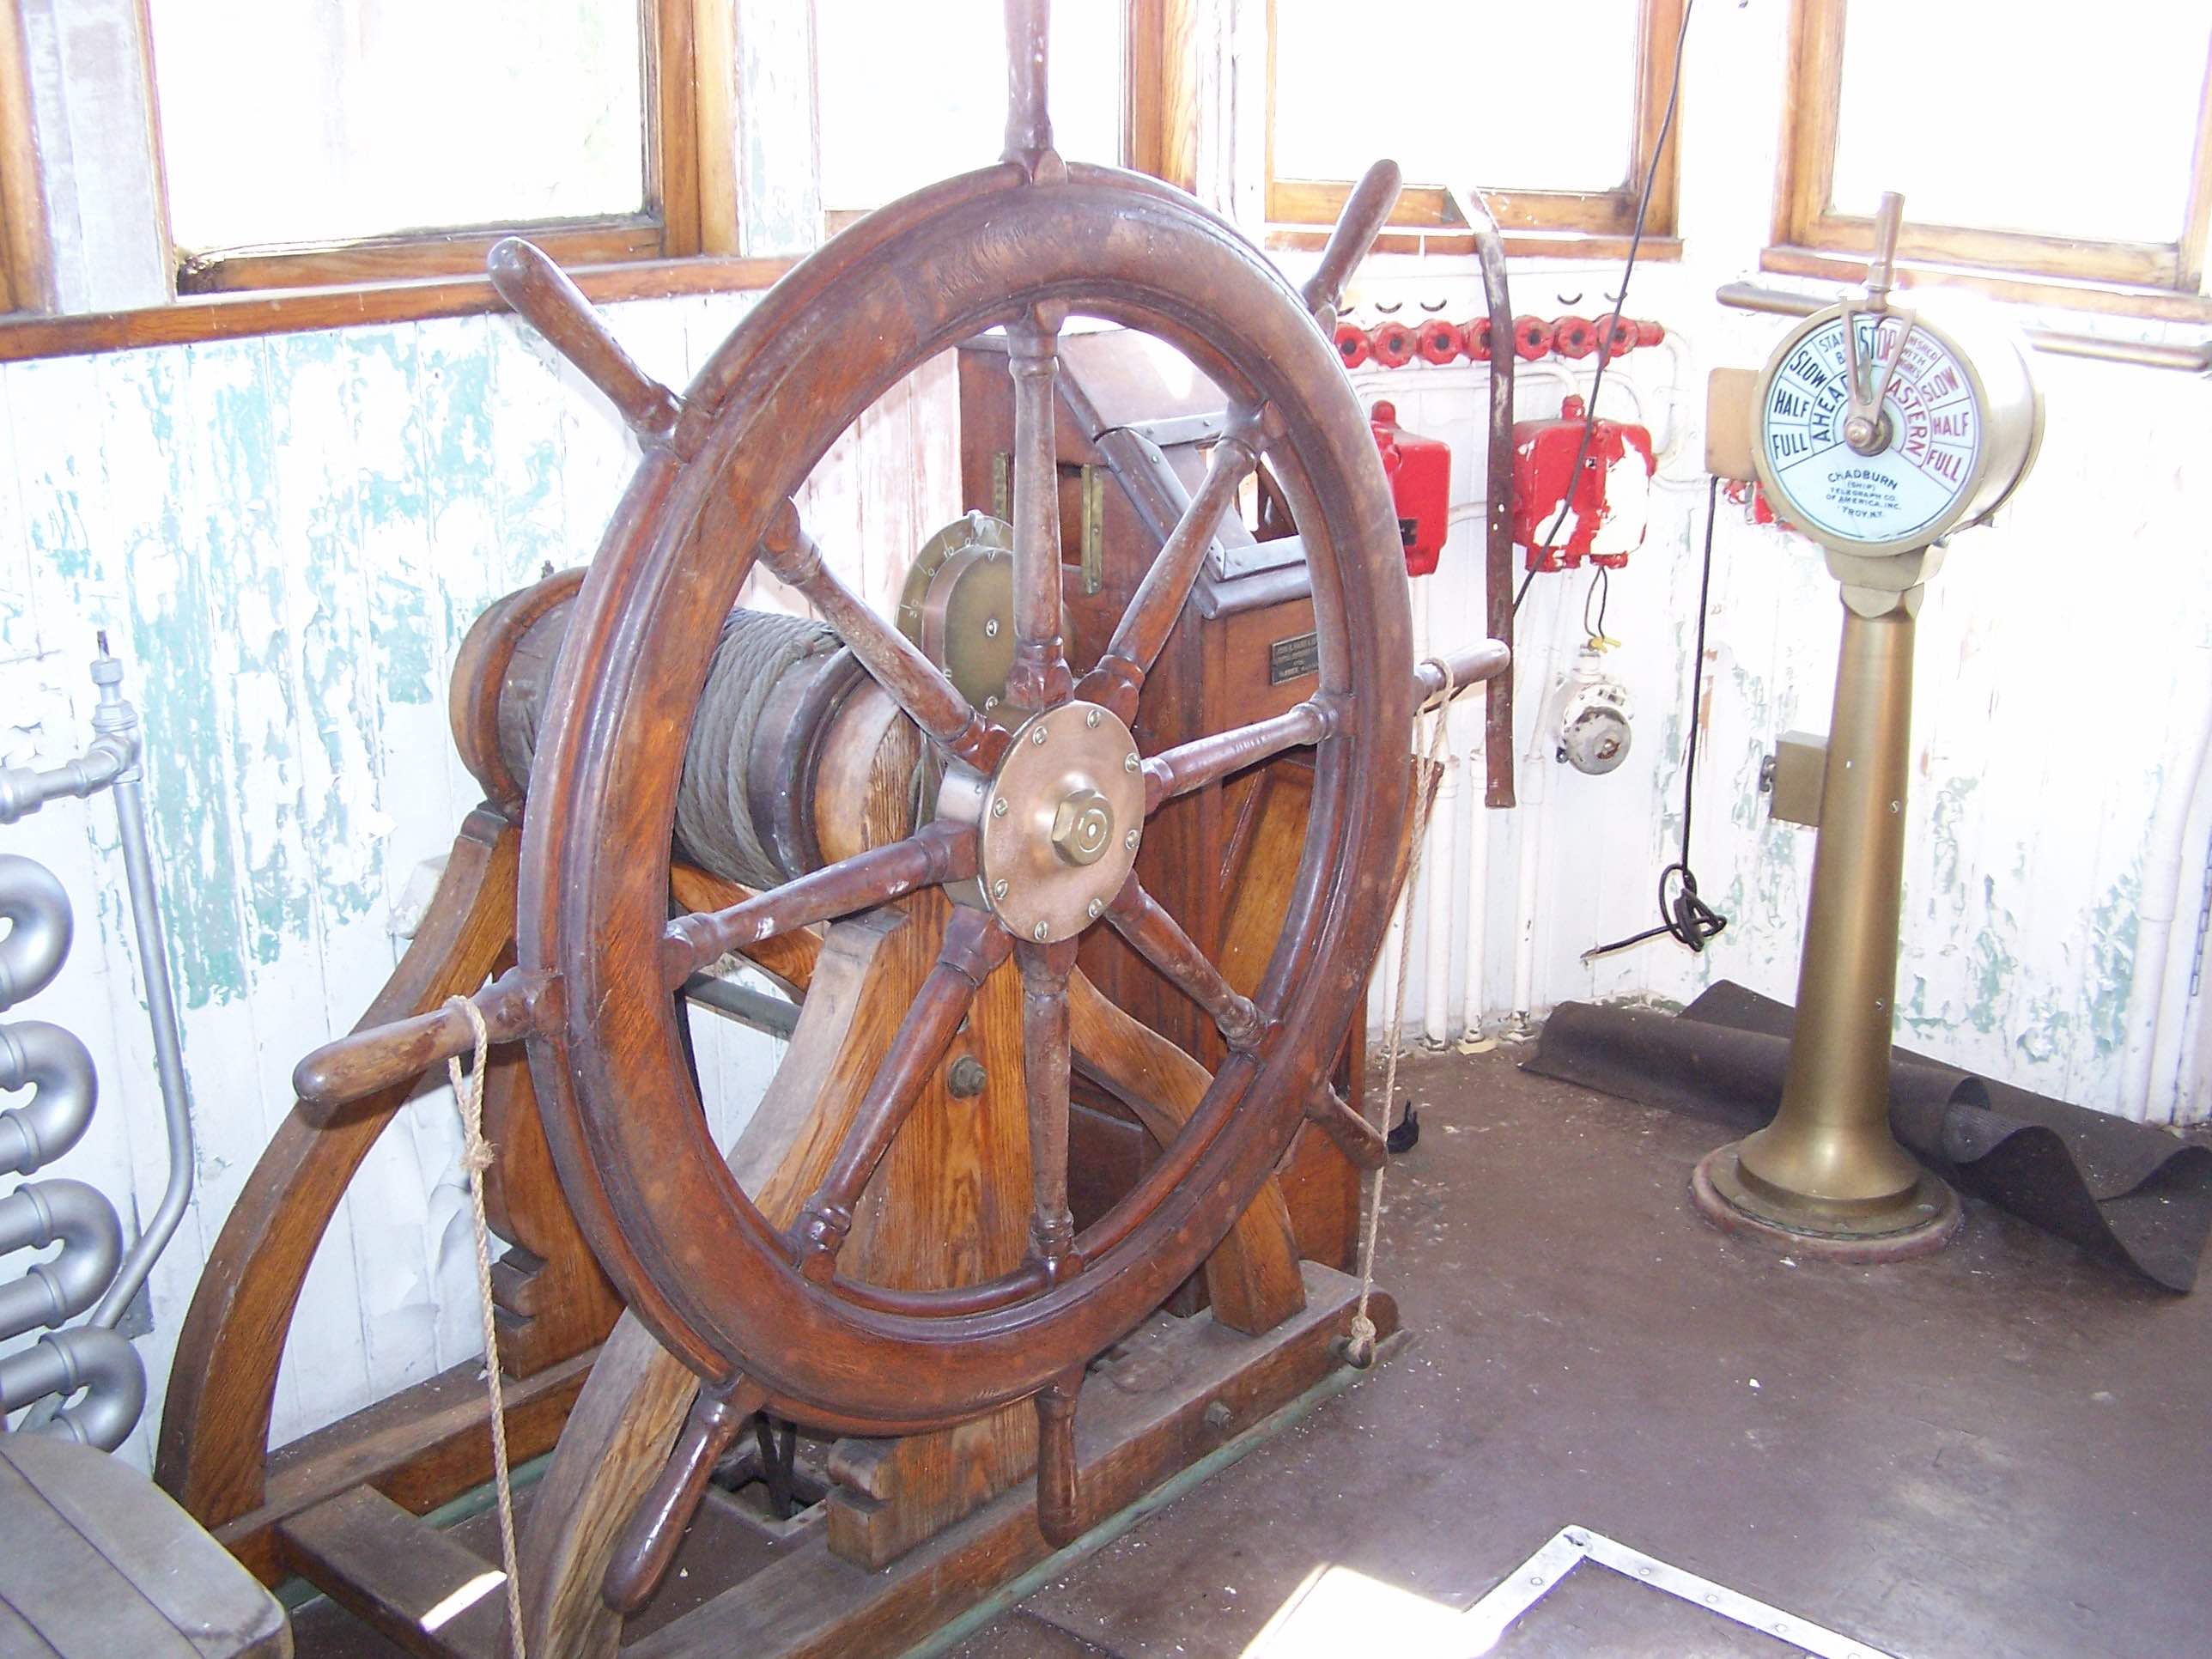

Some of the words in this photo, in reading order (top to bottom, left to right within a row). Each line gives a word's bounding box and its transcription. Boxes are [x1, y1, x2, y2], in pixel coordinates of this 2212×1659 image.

[1818, 331, 1845, 353] STA
[1860, 326, 1896, 362] STOP
[1789, 349, 1828, 389] SLOW
[1920, 365, 1960, 403] SLOW
[1773, 388, 1810, 418] HALF
[1885, 377, 1928, 458] ASTERN
[1932, 411, 1970, 437] HALF
[1771, 433, 1809, 461] FULL
[1827, 468, 1898, 490] CHADBURN
[1926, 448, 1963, 482] FULL
